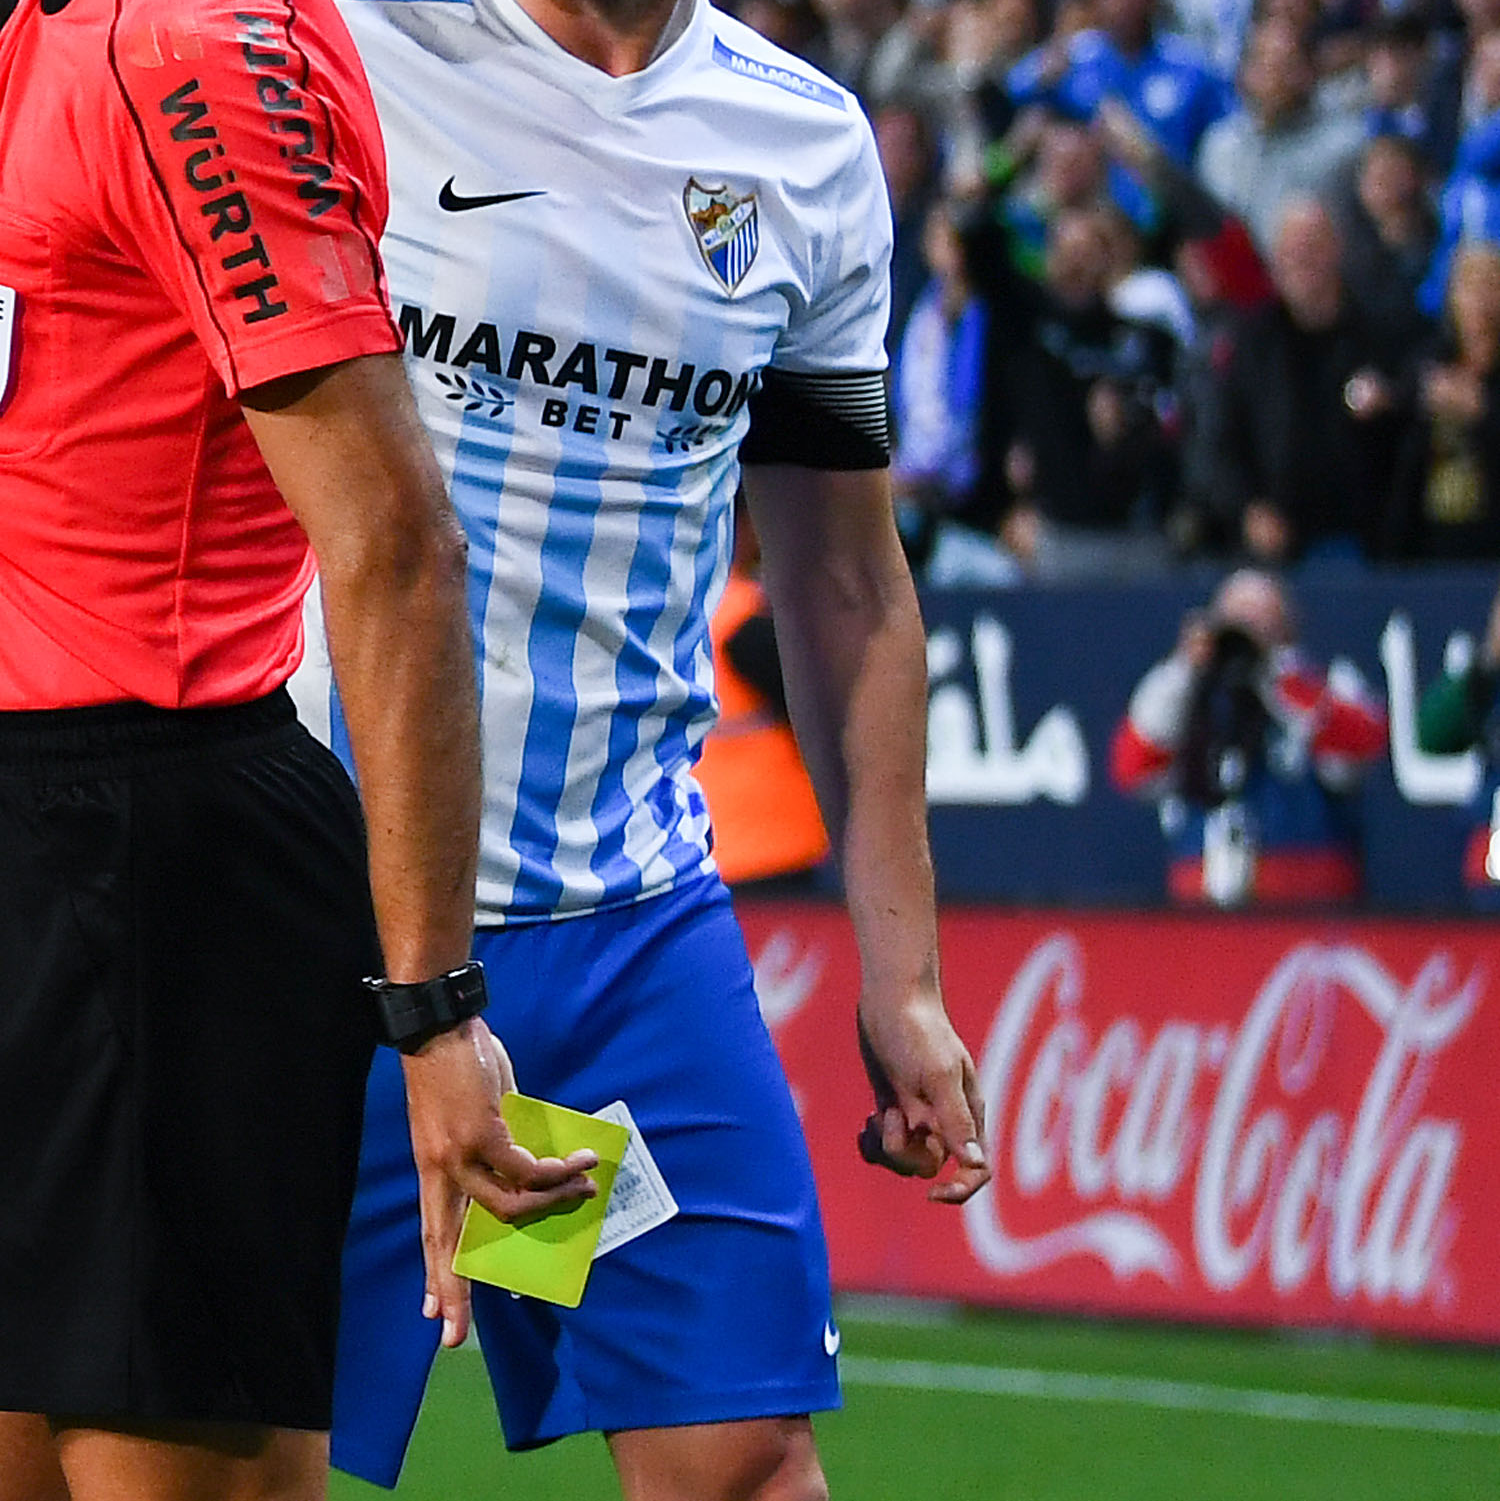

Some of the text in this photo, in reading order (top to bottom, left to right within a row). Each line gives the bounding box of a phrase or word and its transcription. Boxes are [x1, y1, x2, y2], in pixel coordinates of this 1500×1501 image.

[159, 78, 289, 325] WÜRTH
[541, 398, 632, 441] BET
[962, 932, 1484, 1308] Coca-Cola
